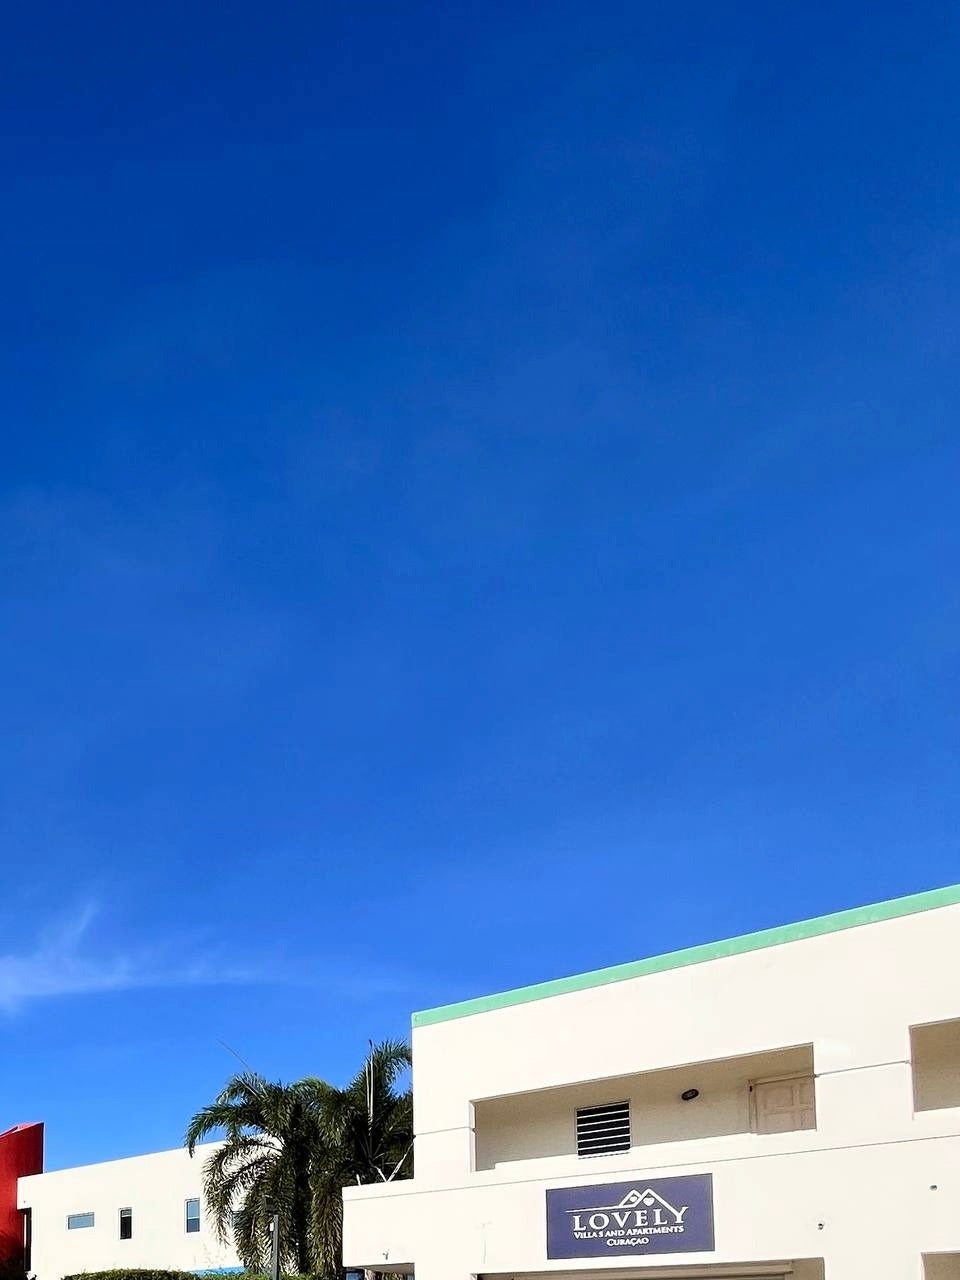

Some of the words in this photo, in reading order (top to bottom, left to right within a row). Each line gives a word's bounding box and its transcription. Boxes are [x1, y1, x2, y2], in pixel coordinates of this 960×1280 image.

[573, 1206, 689, 1231] LOVELY
[605, 1228, 625, 1237] AND
[626, 1225, 685, 1236] APARTMENTS
